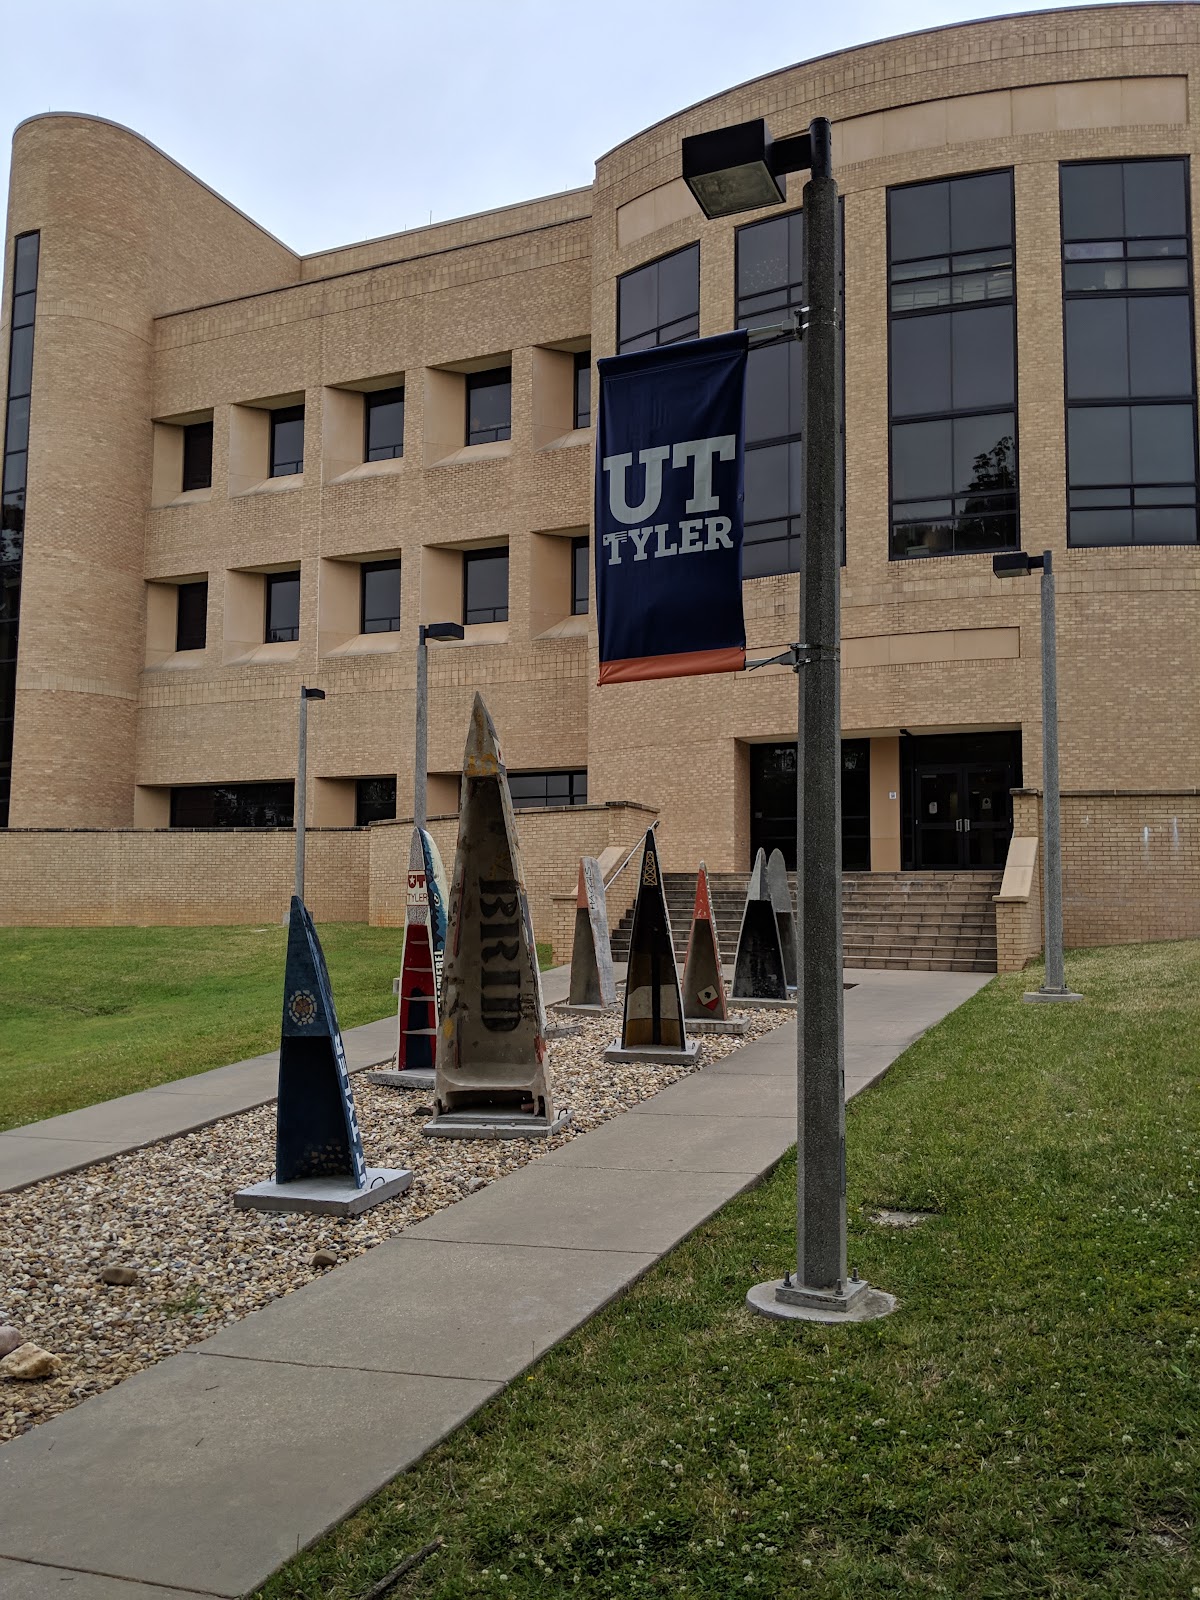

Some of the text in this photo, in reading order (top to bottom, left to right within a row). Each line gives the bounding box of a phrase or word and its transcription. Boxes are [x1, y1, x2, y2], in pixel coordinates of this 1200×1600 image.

[603, 434, 736, 525] UT
[603, 516, 734, 566] TYLER
[408, 875, 426, 888] UT
[334, 1033, 359, 1143] TYLER
